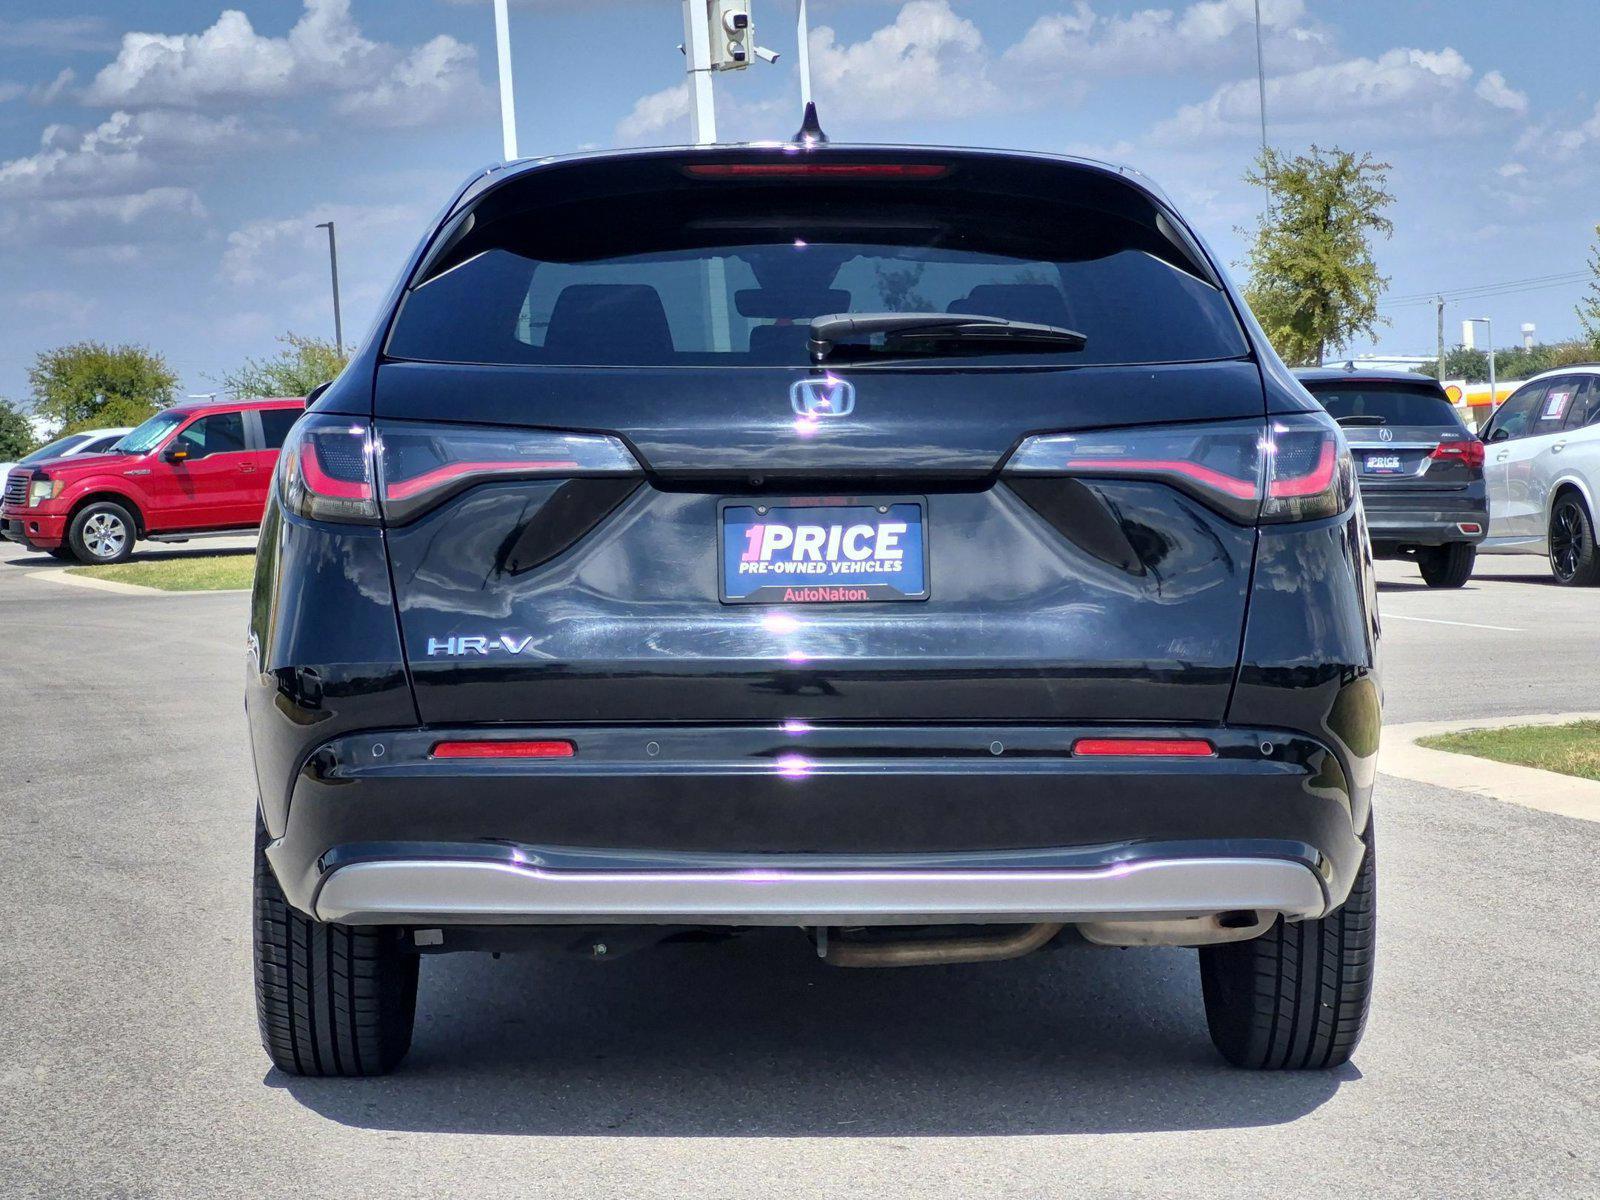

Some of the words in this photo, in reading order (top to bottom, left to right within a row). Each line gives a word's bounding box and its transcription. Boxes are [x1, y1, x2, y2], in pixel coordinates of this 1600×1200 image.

[742, 523, 907, 561] 1PRICE
[739, 561, 828, 574] PRE-OWNED
[830, 560, 903, 573] VEHICLES
[783, 587, 867, 601] AutoNation
[427, 636, 533, 656] HR-V
